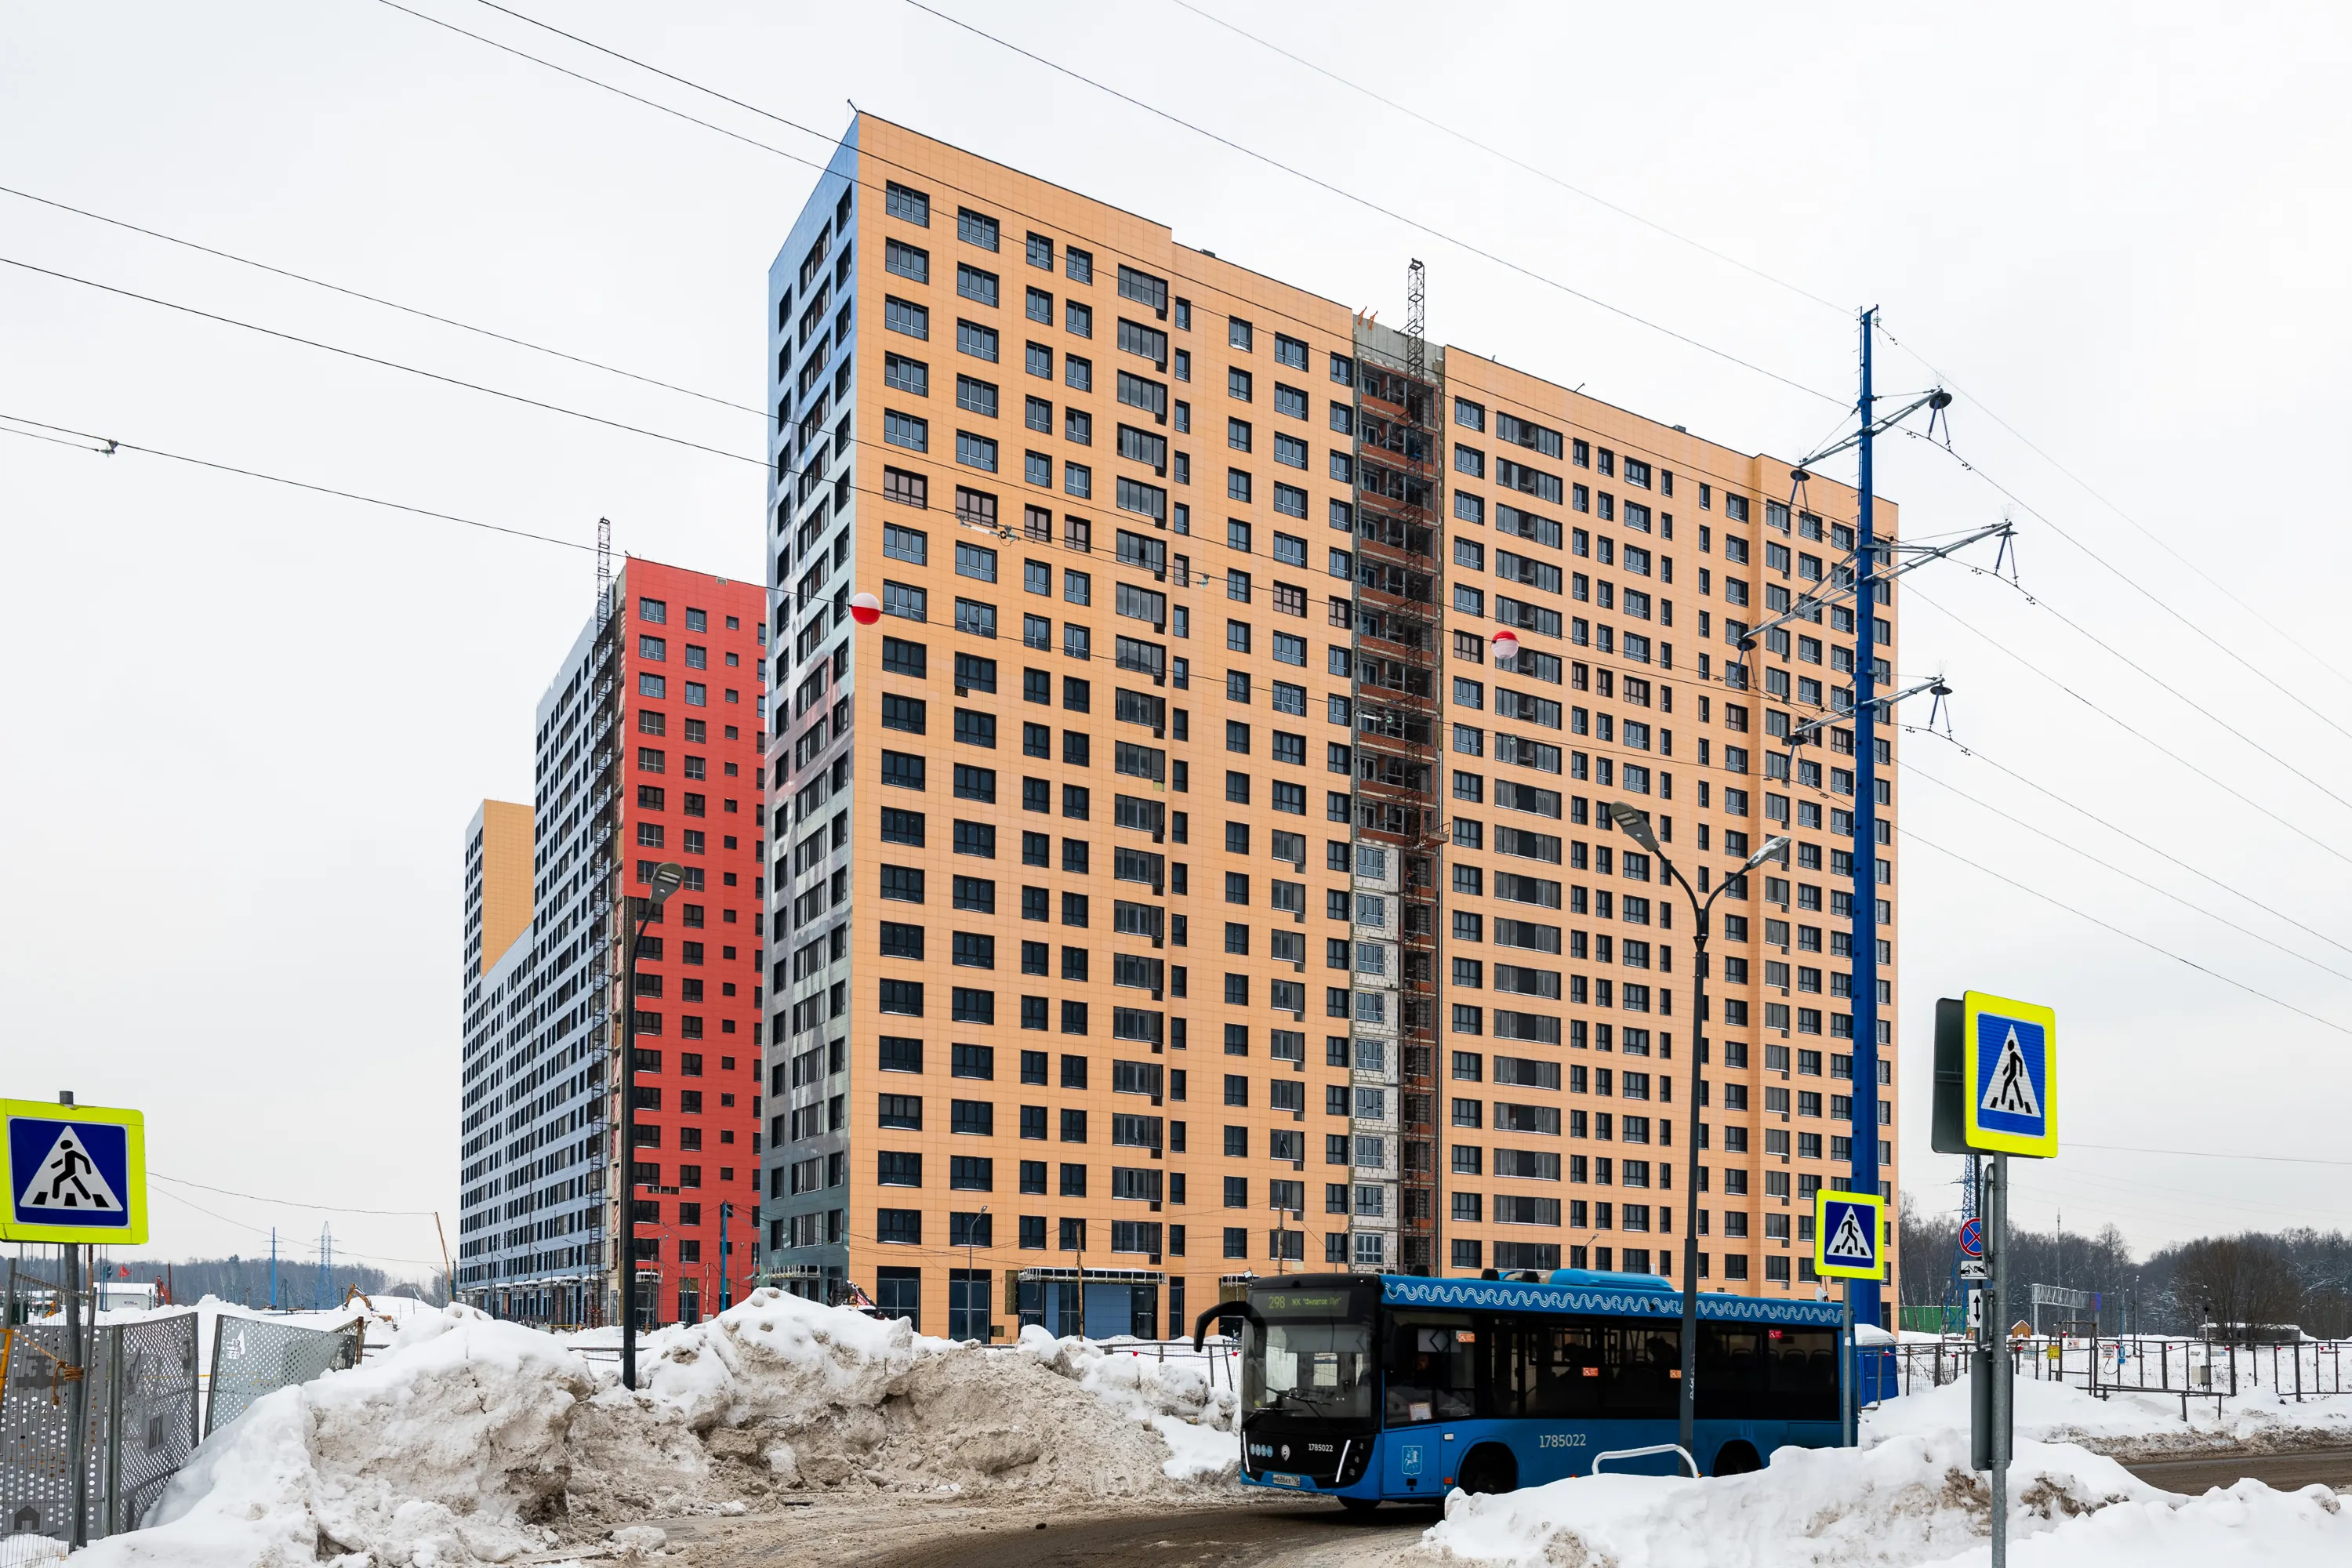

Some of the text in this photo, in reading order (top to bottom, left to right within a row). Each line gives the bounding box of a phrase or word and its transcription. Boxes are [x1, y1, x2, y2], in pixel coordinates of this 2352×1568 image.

[1269, 1296, 1286, 1308] 298
[1539, 1434, 1587, 1448] 1785022
[1308, 1443, 1334, 1452] 1785022
